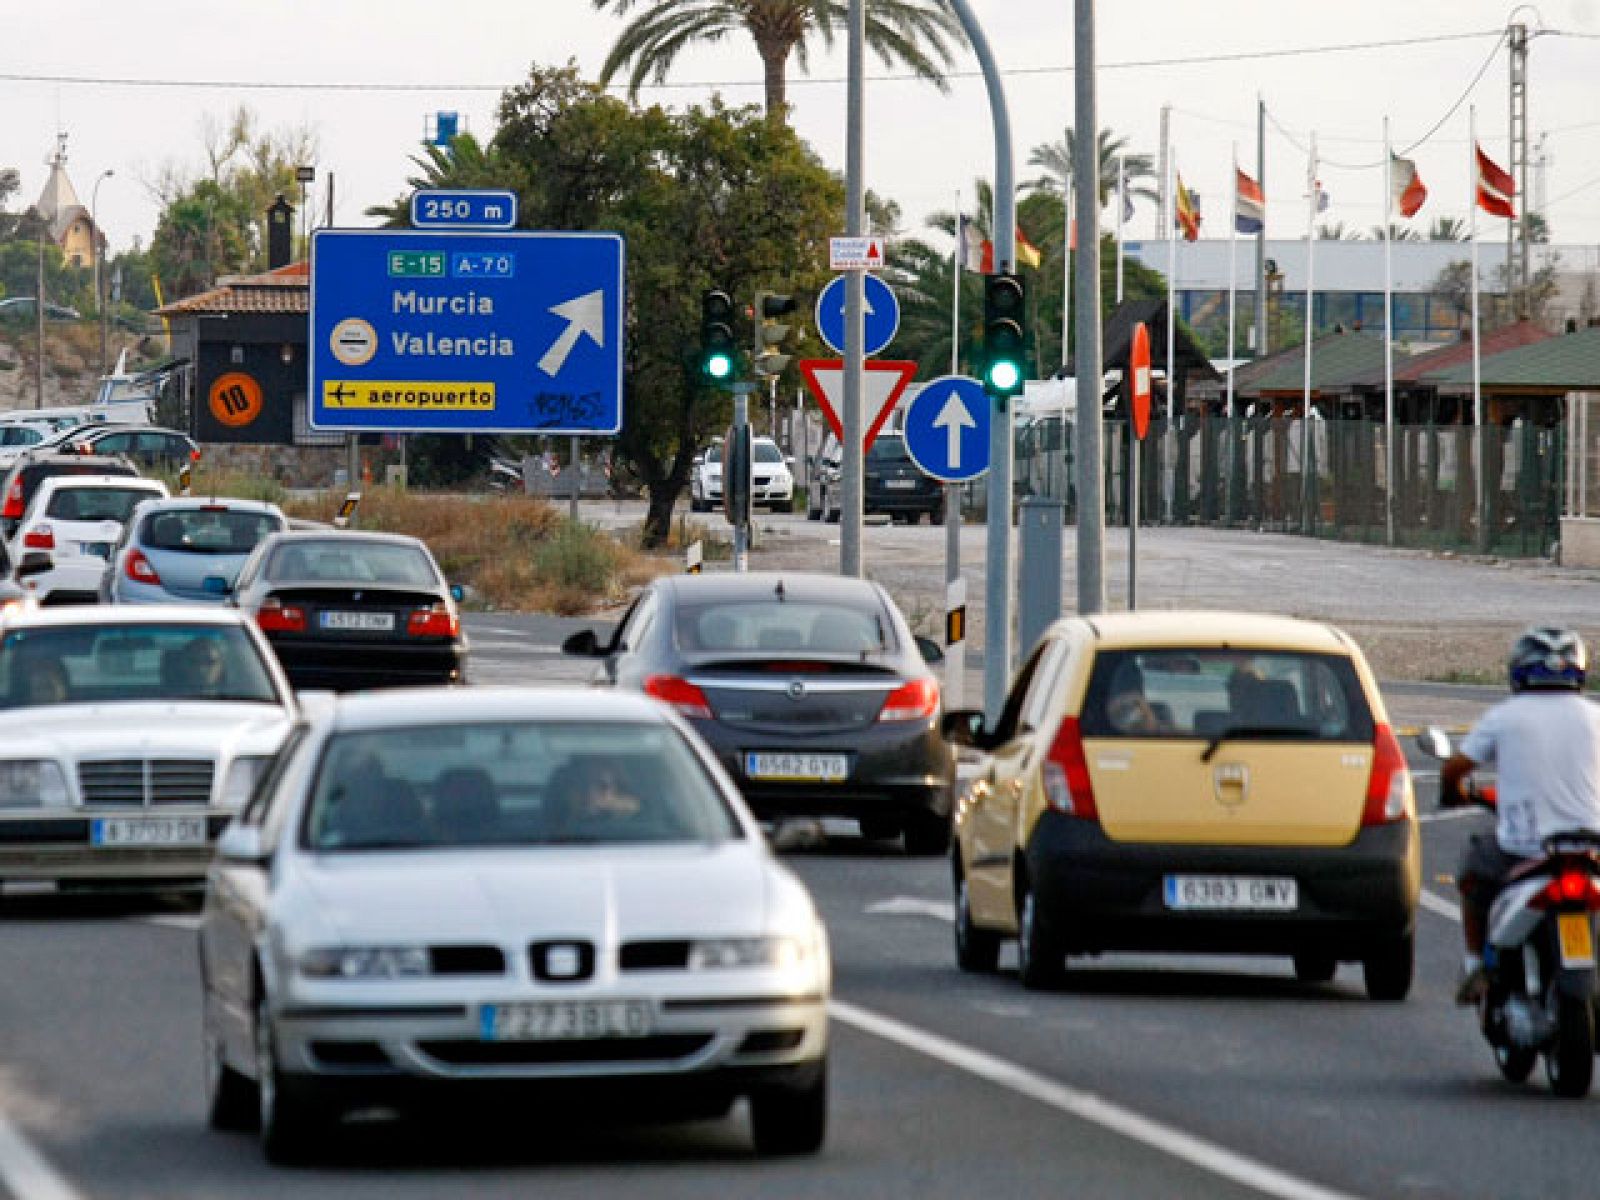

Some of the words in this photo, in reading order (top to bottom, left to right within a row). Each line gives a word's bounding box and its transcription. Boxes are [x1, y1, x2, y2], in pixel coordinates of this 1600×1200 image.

[424, 200, 471, 219] 250
[484, 203, 503, 219] m
[391, 256, 442, 274] E-15
[458, 256, 509, 274] A-70
[391, 290, 494, 315] Murcia
[391, 332, 515, 356] Valencia
[219, 384, 249, 416] 10
[368, 388, 492, 407] aeropuerto
